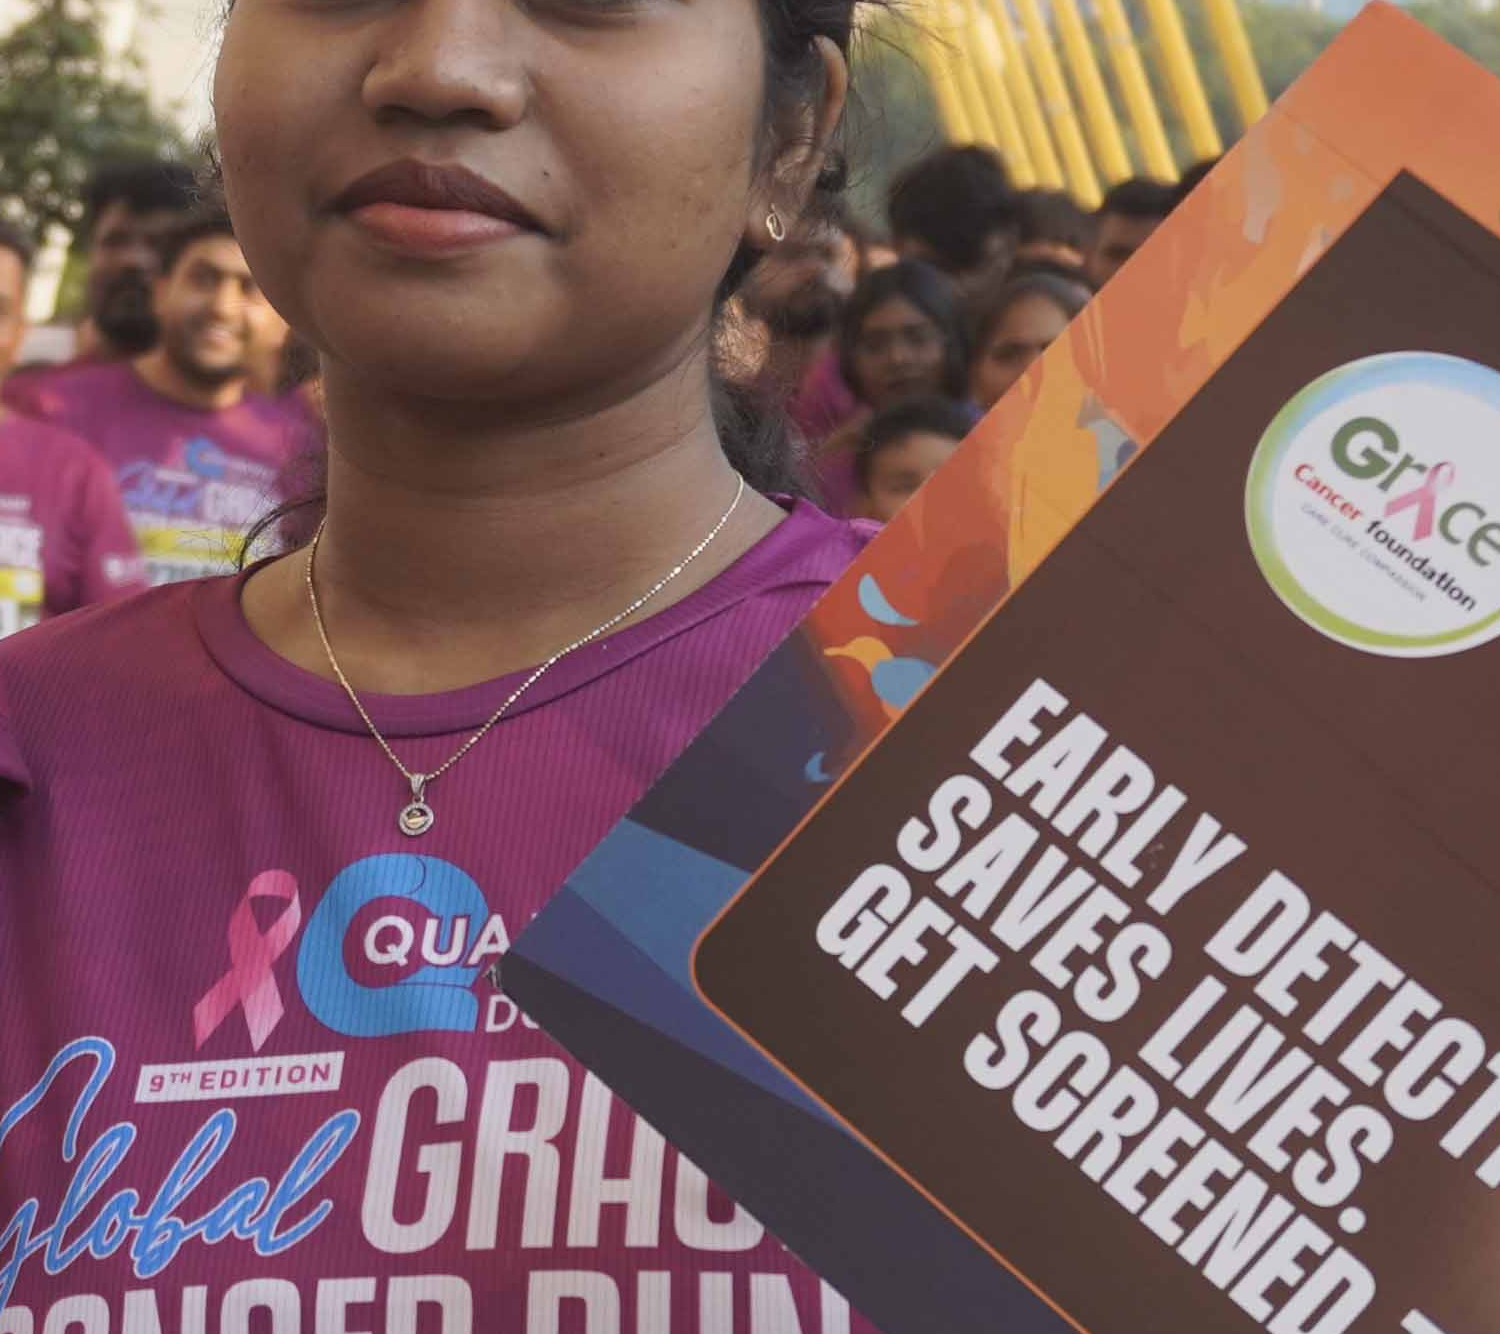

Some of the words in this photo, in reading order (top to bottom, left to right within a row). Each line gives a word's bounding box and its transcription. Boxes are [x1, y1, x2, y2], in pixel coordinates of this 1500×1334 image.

[1293, 462, 1364, 522] Cancer
[1364, 519, 1478, 612] foundation
[968, 677, 1247, 918] EARLY
[814, 861, 999, 1029] GET
[895, 773, 1173, 1024] SAVES
[1137, 973, 1396, 1235] LIVES.
[199, 1063, 331, 1092] EDITION
